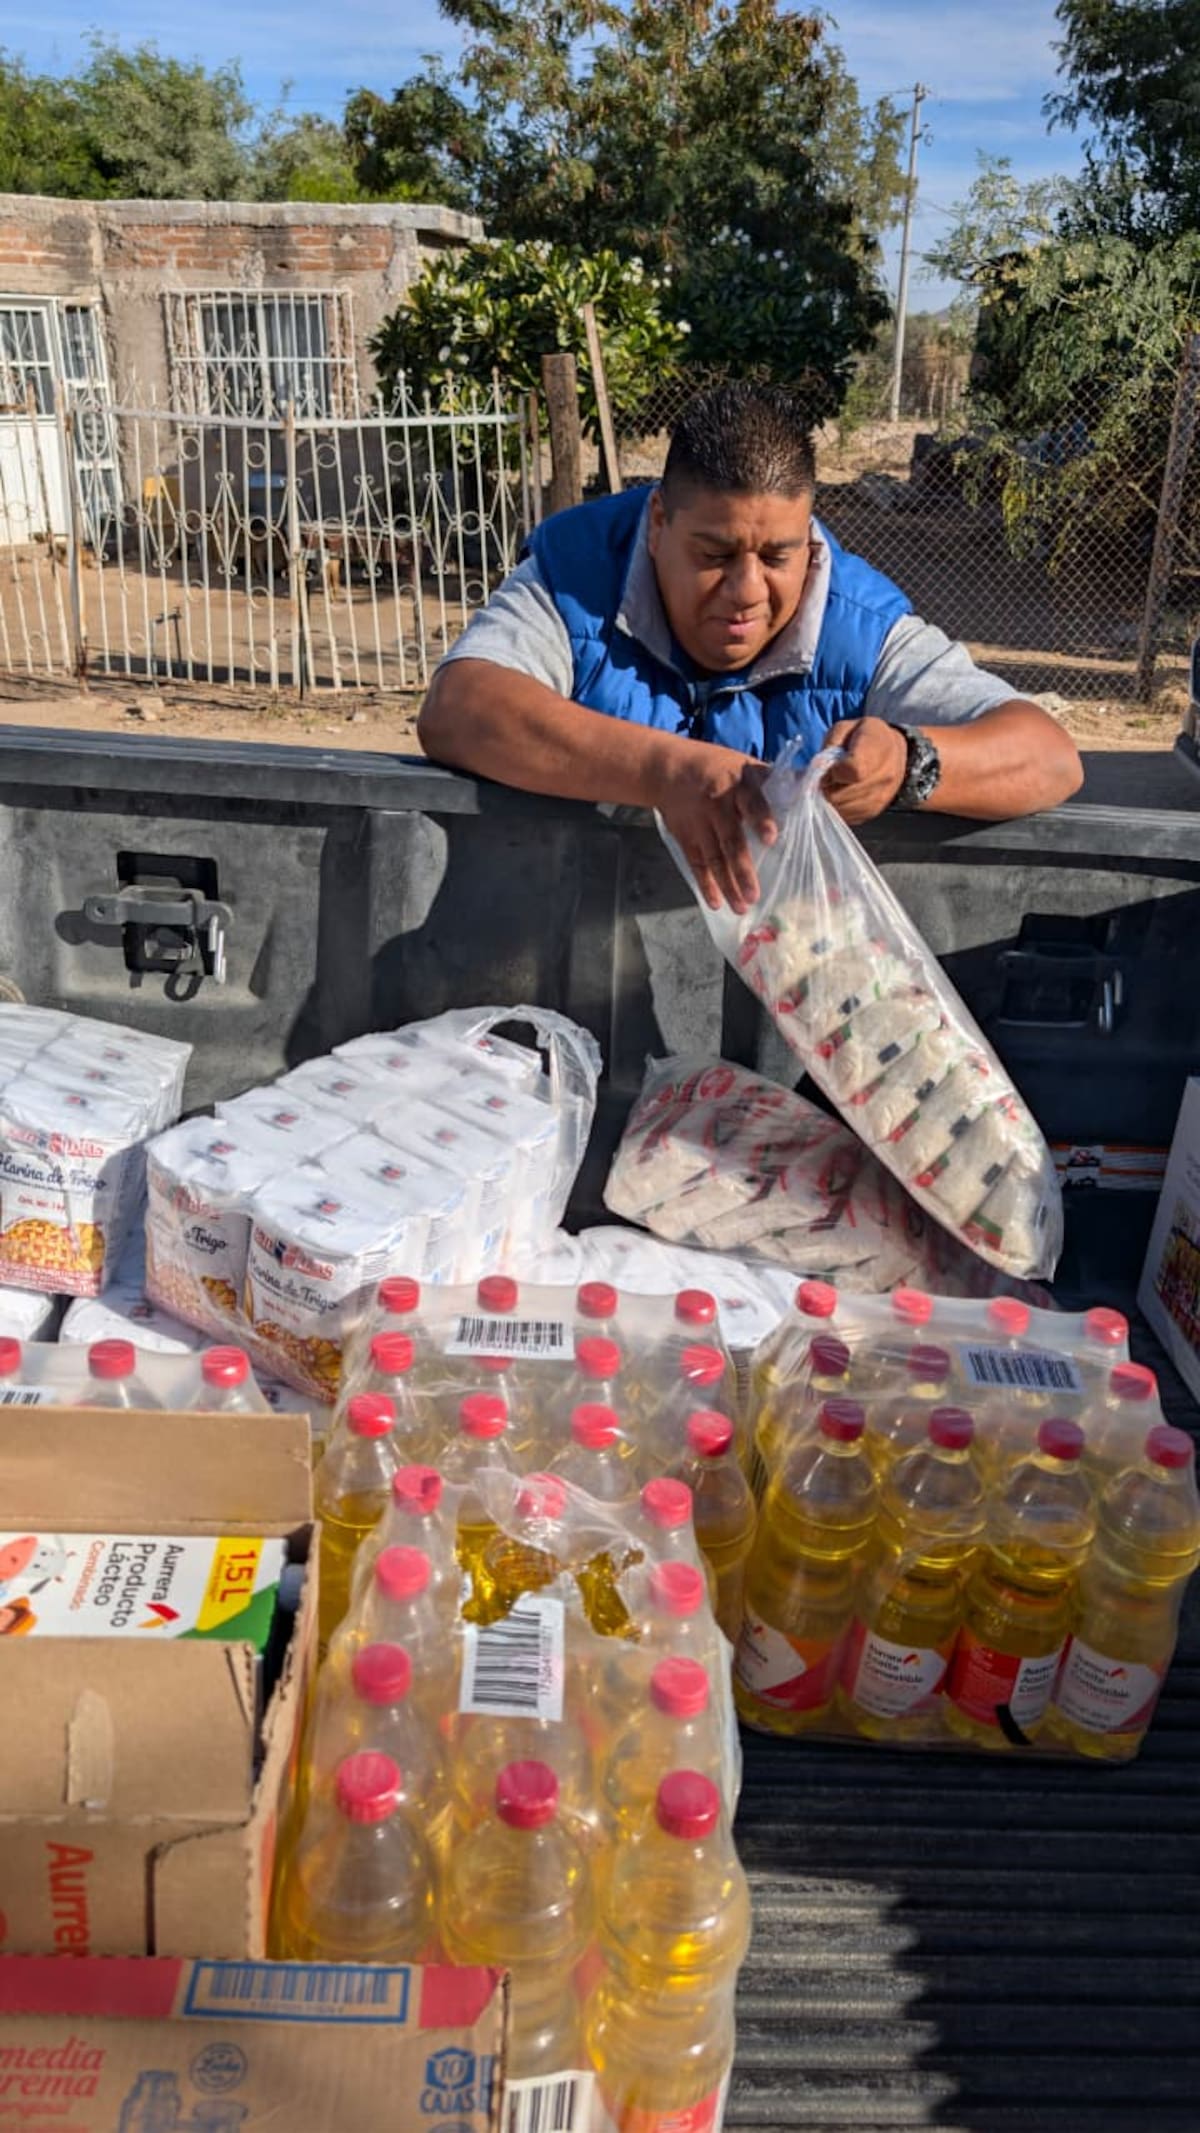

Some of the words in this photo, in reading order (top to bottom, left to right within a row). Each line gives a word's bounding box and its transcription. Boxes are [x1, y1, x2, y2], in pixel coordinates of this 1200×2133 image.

[191, 1226, 227, 1255] Trigo
[300, 1285, 340, 1316] Trigo
[93, 1541, 134, 1607] Lácteo
[110, 1542, 157, 1629] Producto
[151, 1543, 185, 1602] Aurrera
[419, 2087, 476, 2115] CAJAS
